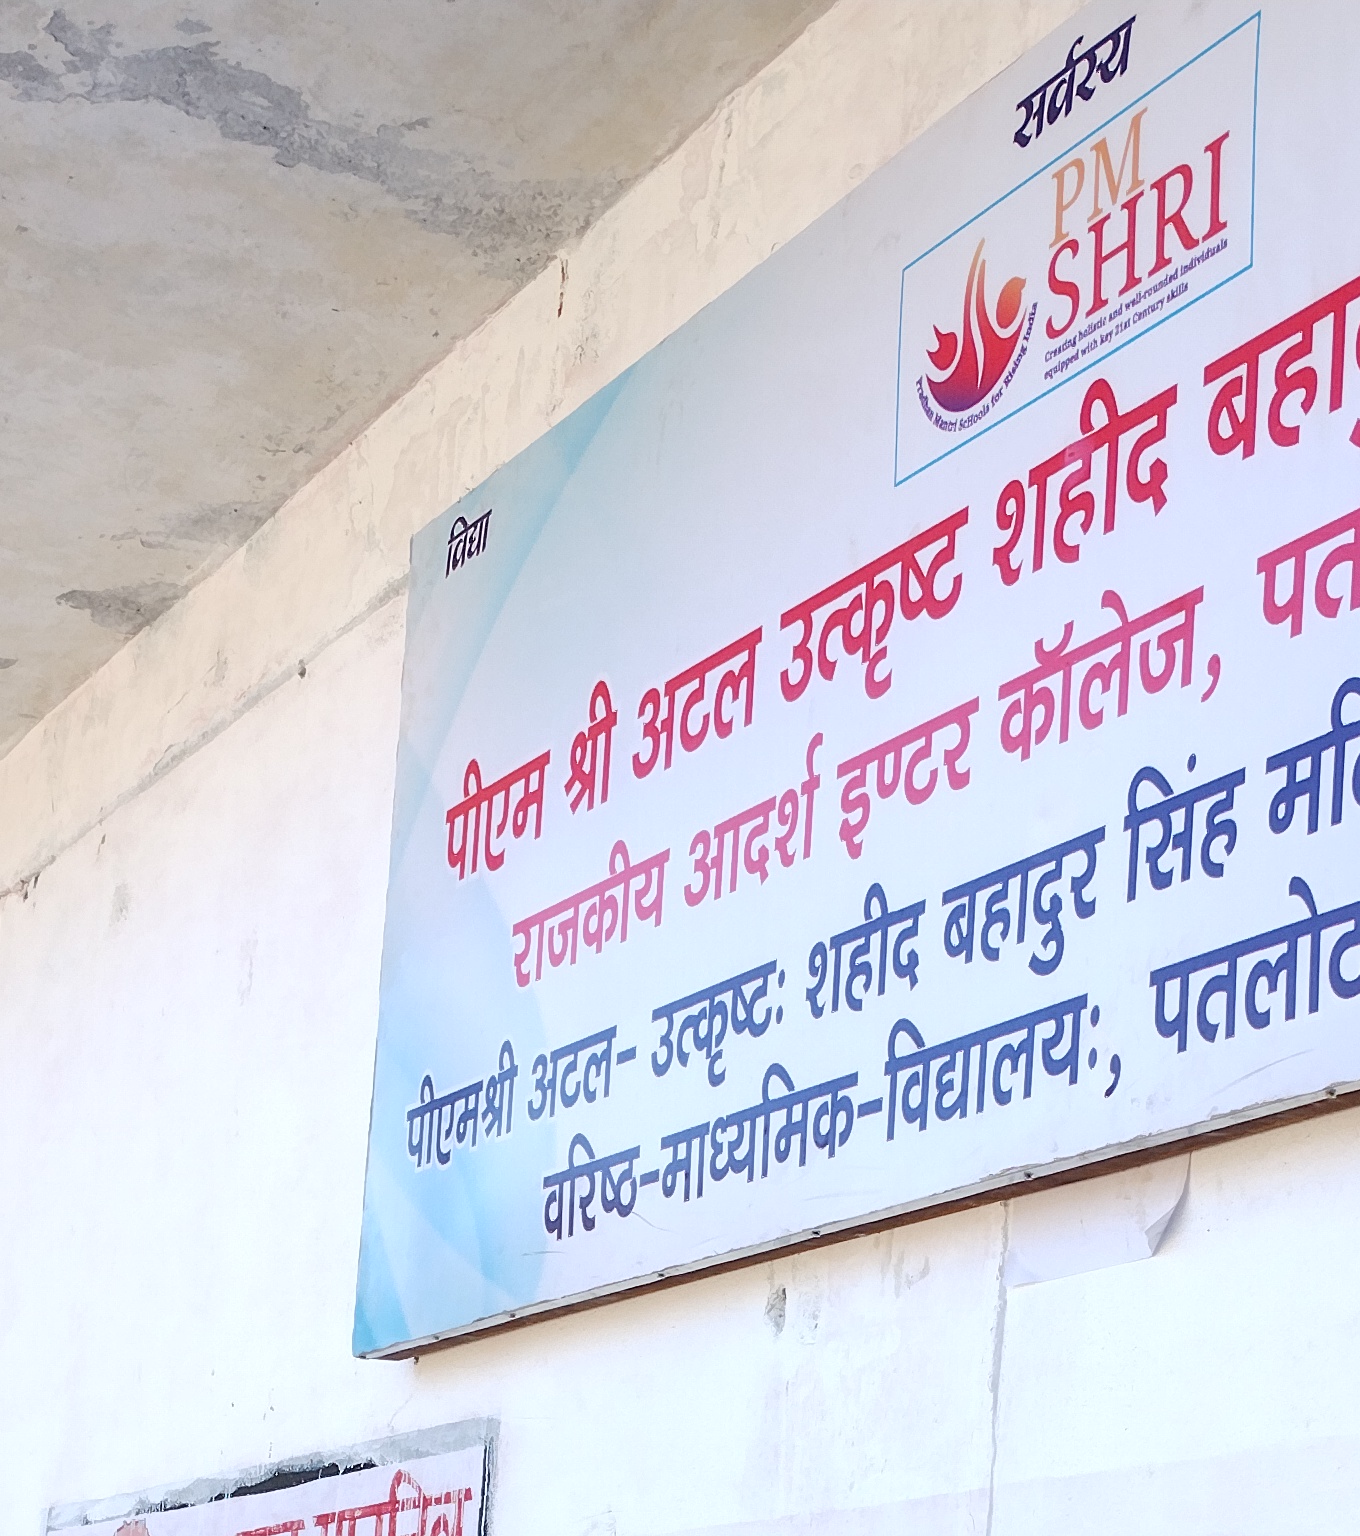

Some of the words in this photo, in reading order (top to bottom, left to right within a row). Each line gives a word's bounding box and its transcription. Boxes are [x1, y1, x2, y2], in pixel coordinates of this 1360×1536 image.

[1046, 130, 1229, 340] SHRI
[1048, 107, 1148, 248] PM
[1080, 338, 1099, 358] with
[1108, 303, 1123, 322] and
[445, 757, 550, 880] पीएम
[564, 680, 619, 814] श्री
[632, 624, 763, 775] अटल
[780, 506, 968, 700] उत्कृष्ट
[993, 379, 1178, 586] शहीद
[512, 840, 669, 987] राजकीय
[684, 732, 824, 907] आदर्श
[837, 697, 979, 862] इण्टर
[998, 585, 1221, 763] कॉलेज,
[407, 1039, 516, 1167] पीएमश्री
[528, 1025, 637, 1122] अटल-
[651, 960, 785, 1086] उत्कृष्टः
[807, 883, 926, 1021] शहीद
[943, 825, 1105, 977] बहादुर
[1124, 754, 1245, 902] सिंह
